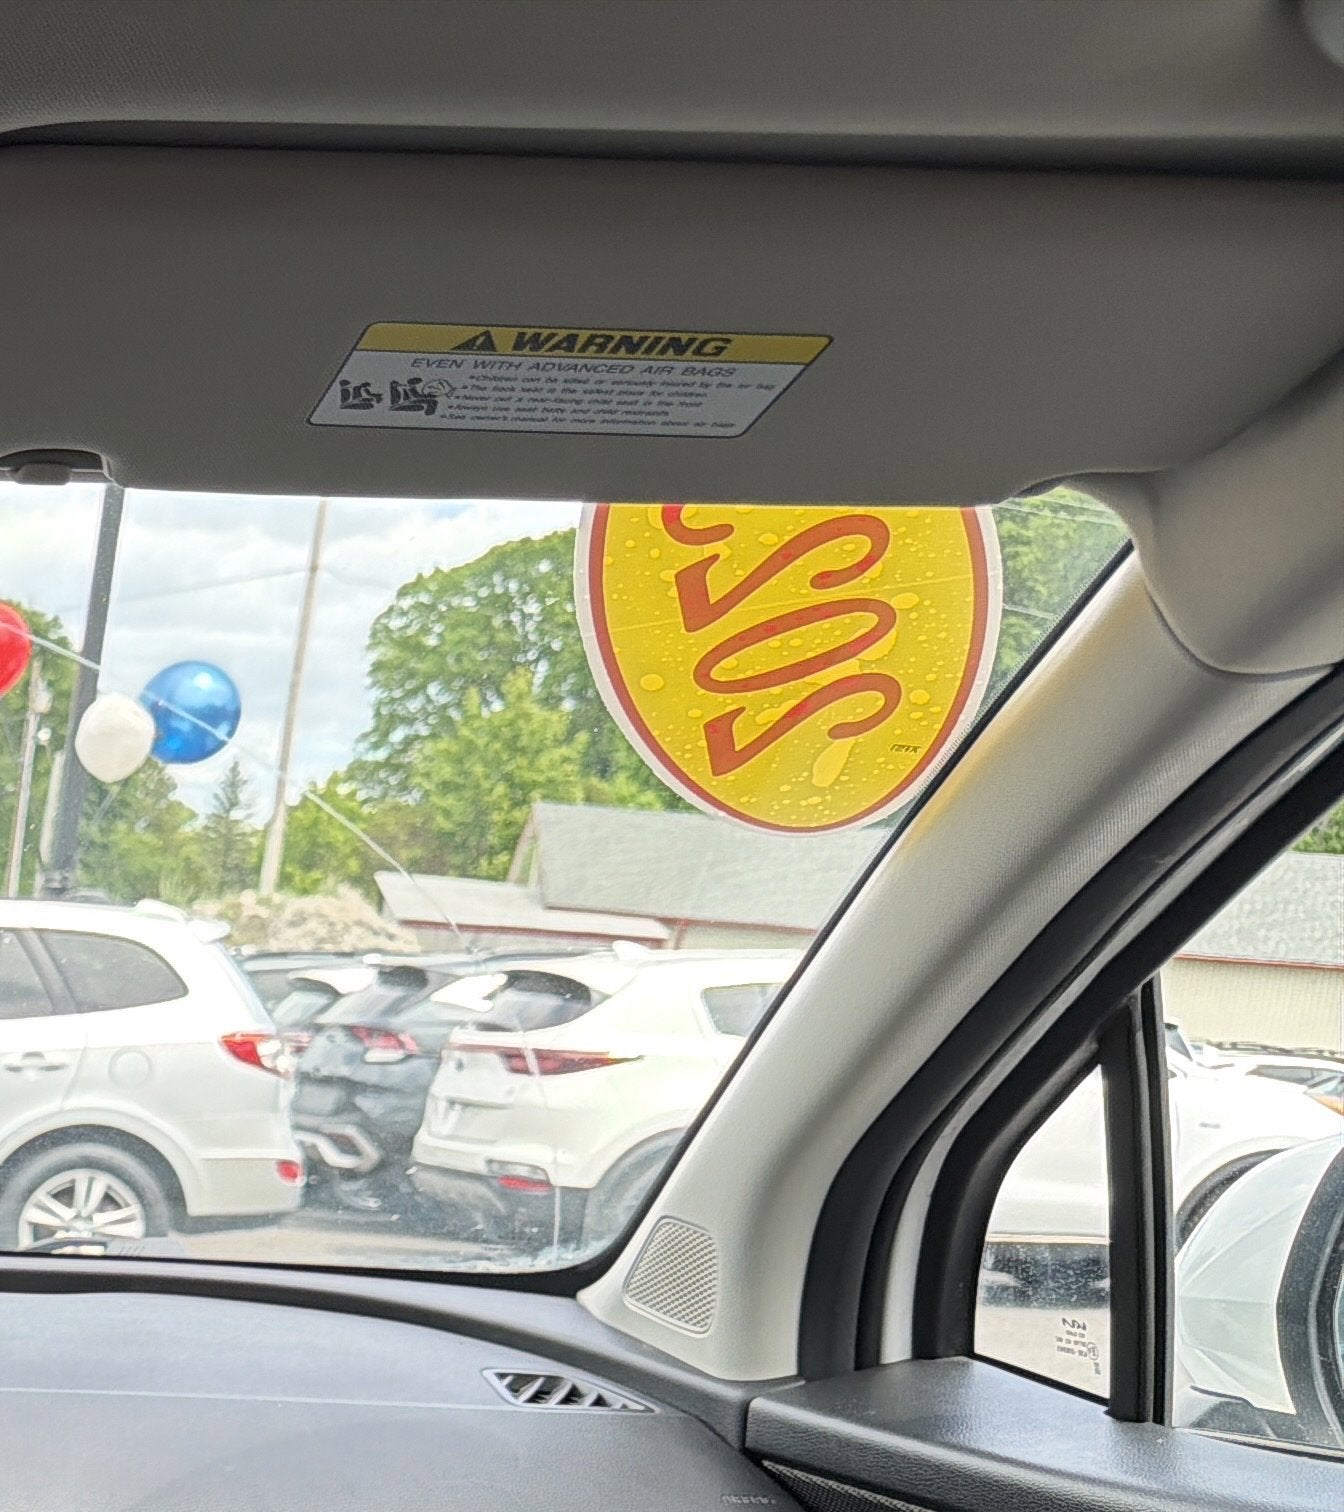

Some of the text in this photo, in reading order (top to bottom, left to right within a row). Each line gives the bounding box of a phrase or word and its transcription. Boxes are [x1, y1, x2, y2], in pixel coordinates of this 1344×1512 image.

[512, 331, 734, 357] WARNING
[411, 358, 737, 377] EVEN WITH ADVANCED AIR BAGS
